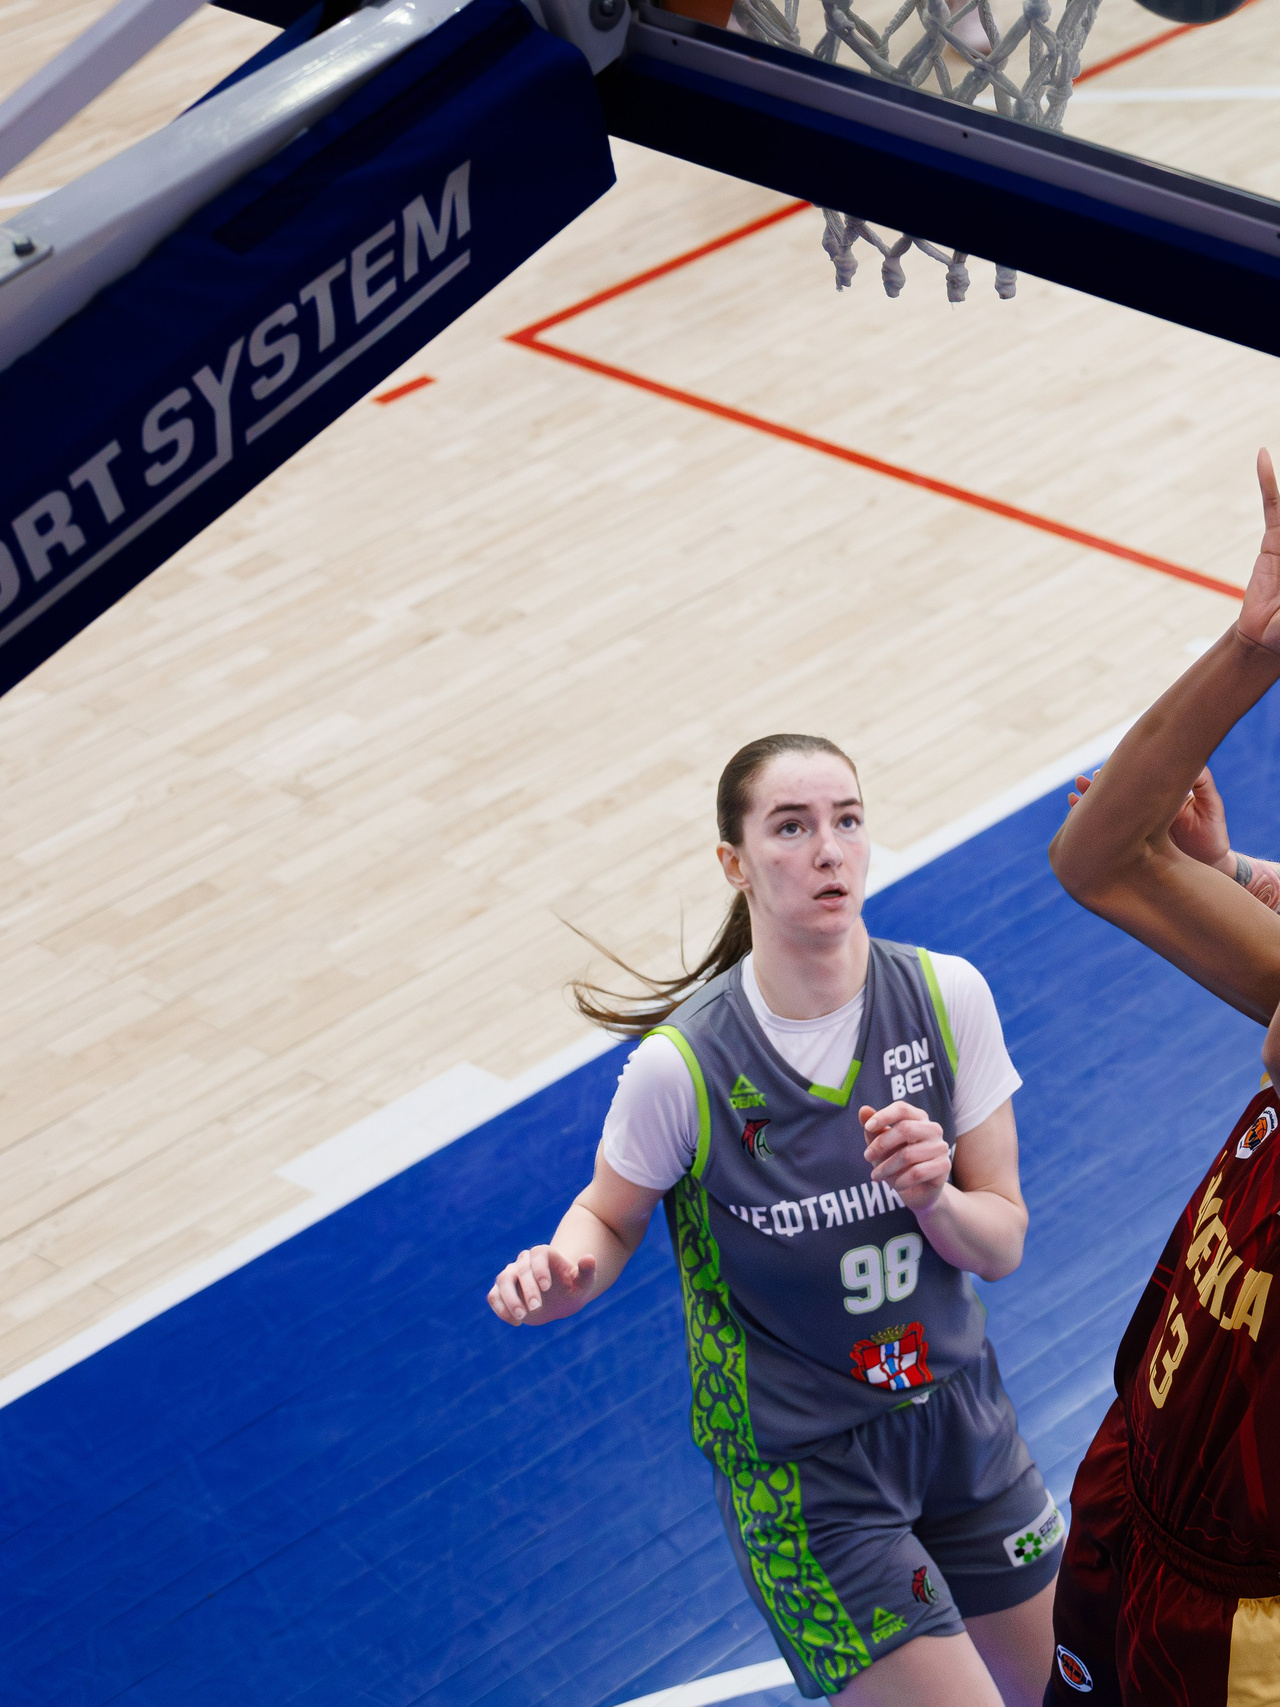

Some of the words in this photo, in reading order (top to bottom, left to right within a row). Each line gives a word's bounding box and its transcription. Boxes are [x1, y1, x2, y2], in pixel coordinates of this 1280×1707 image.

[142, 160, 471, 487] SYSTEM
[883, 1037, 930, 1075] FON
[890, 1062, 935, 1101] BET
[840, 1231, 923, 1316] 98
